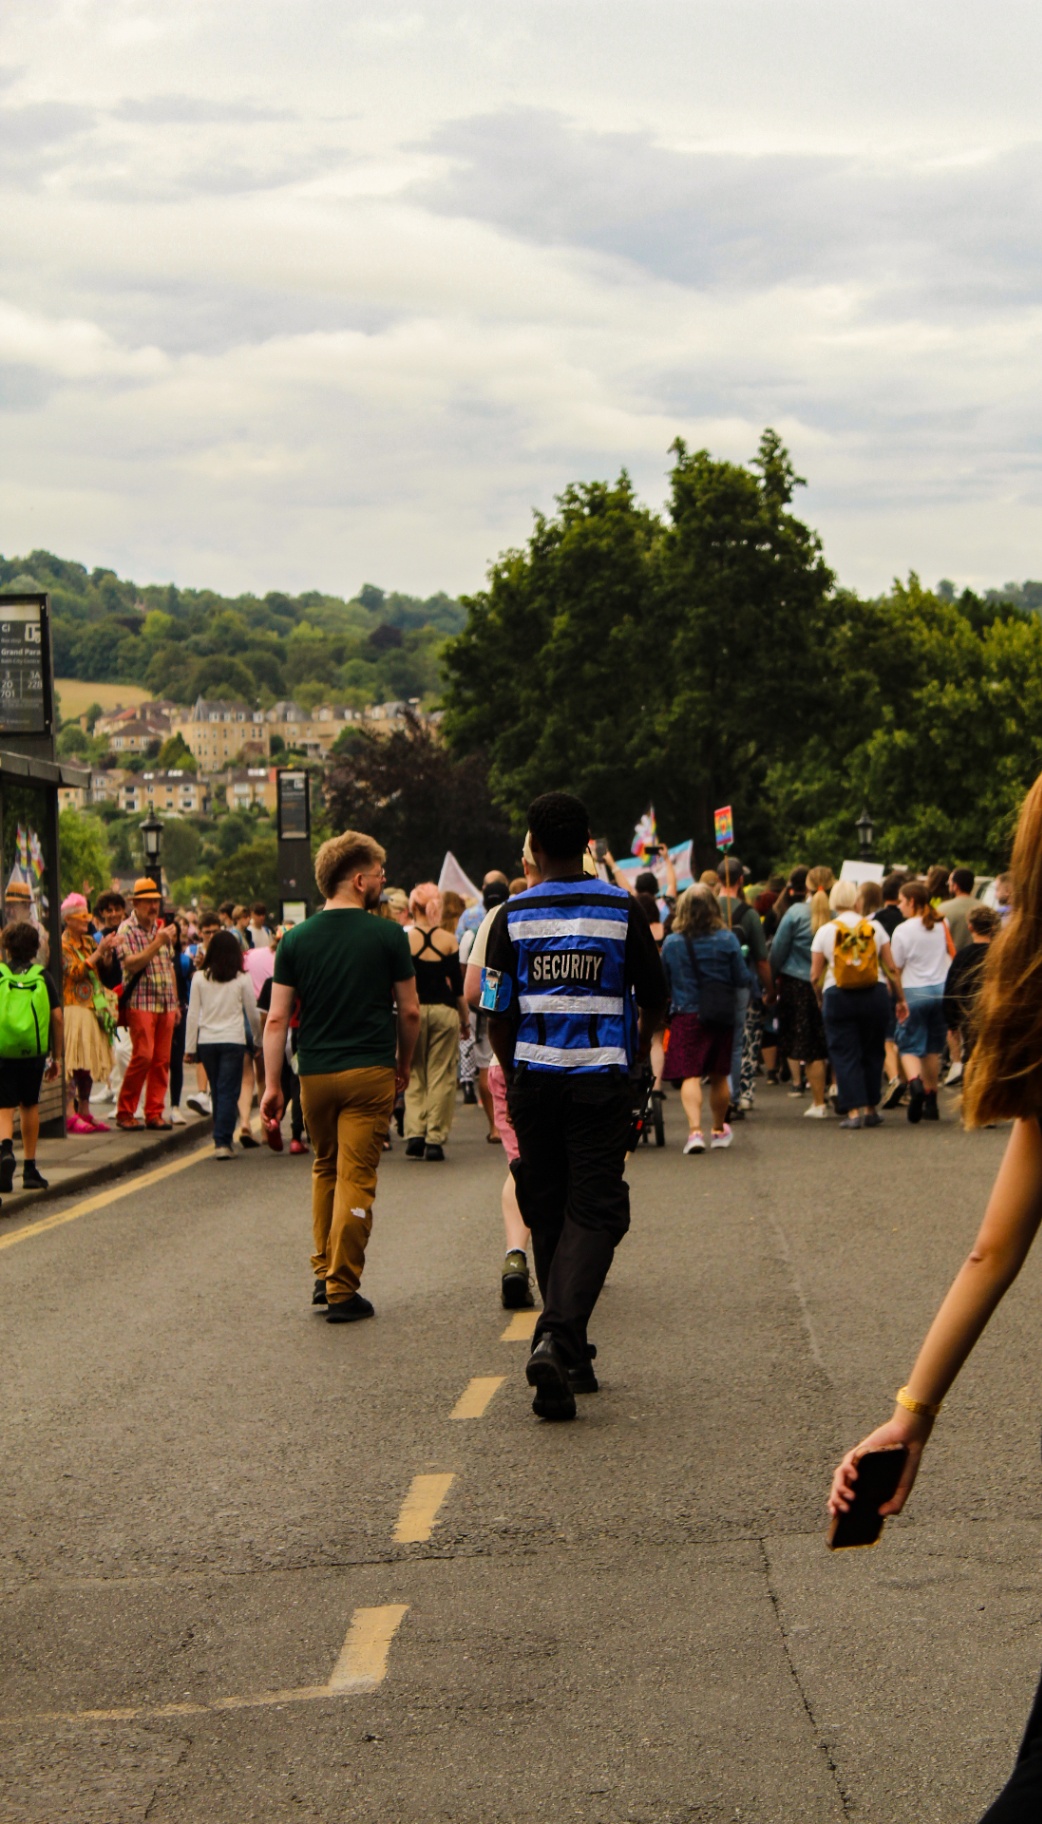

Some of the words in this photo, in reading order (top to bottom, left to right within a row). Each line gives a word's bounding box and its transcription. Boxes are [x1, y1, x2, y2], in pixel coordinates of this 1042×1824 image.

[1, 648, 23, 656] Grand
[2, 680, 13, 689] 20
[1, 690, 15, 698] 701
[533, 954, 602, 980] SECURITY
